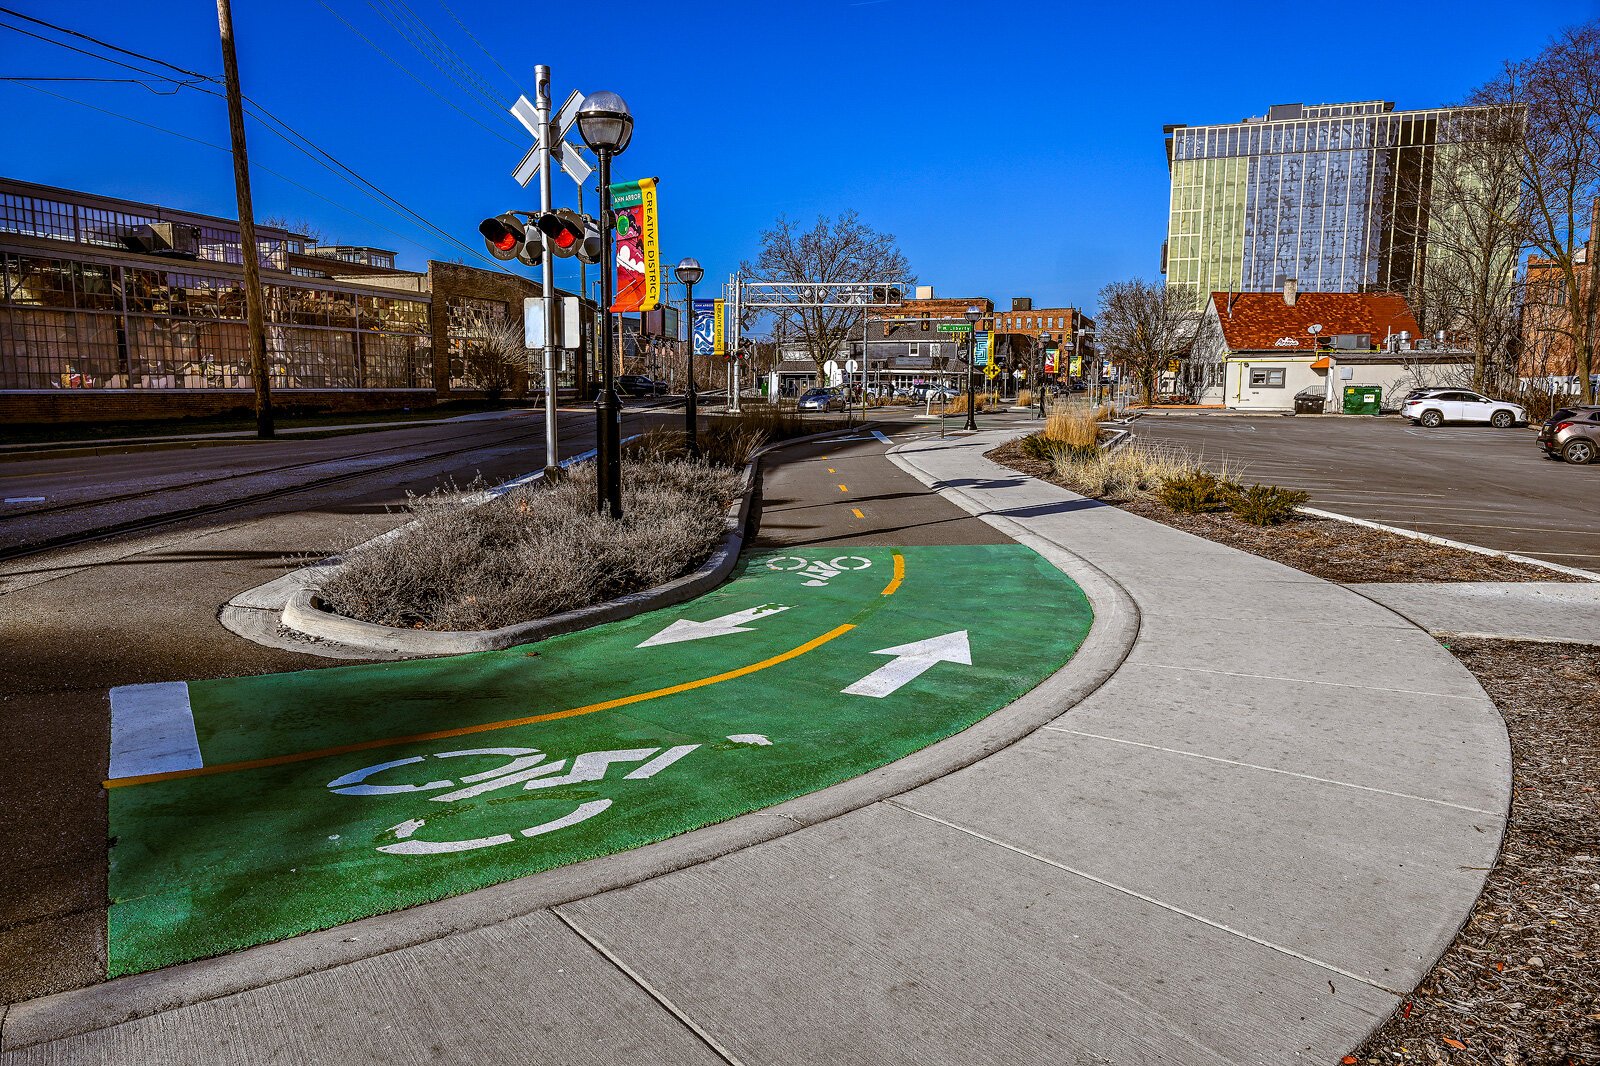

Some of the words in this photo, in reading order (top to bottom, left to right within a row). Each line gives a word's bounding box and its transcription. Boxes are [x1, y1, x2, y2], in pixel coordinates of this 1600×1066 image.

[625, 192, 641, 201] ARBOR
[646, 191, 655, 247] CREATIVE
[647, 250, 657, 300] DISTRICT
